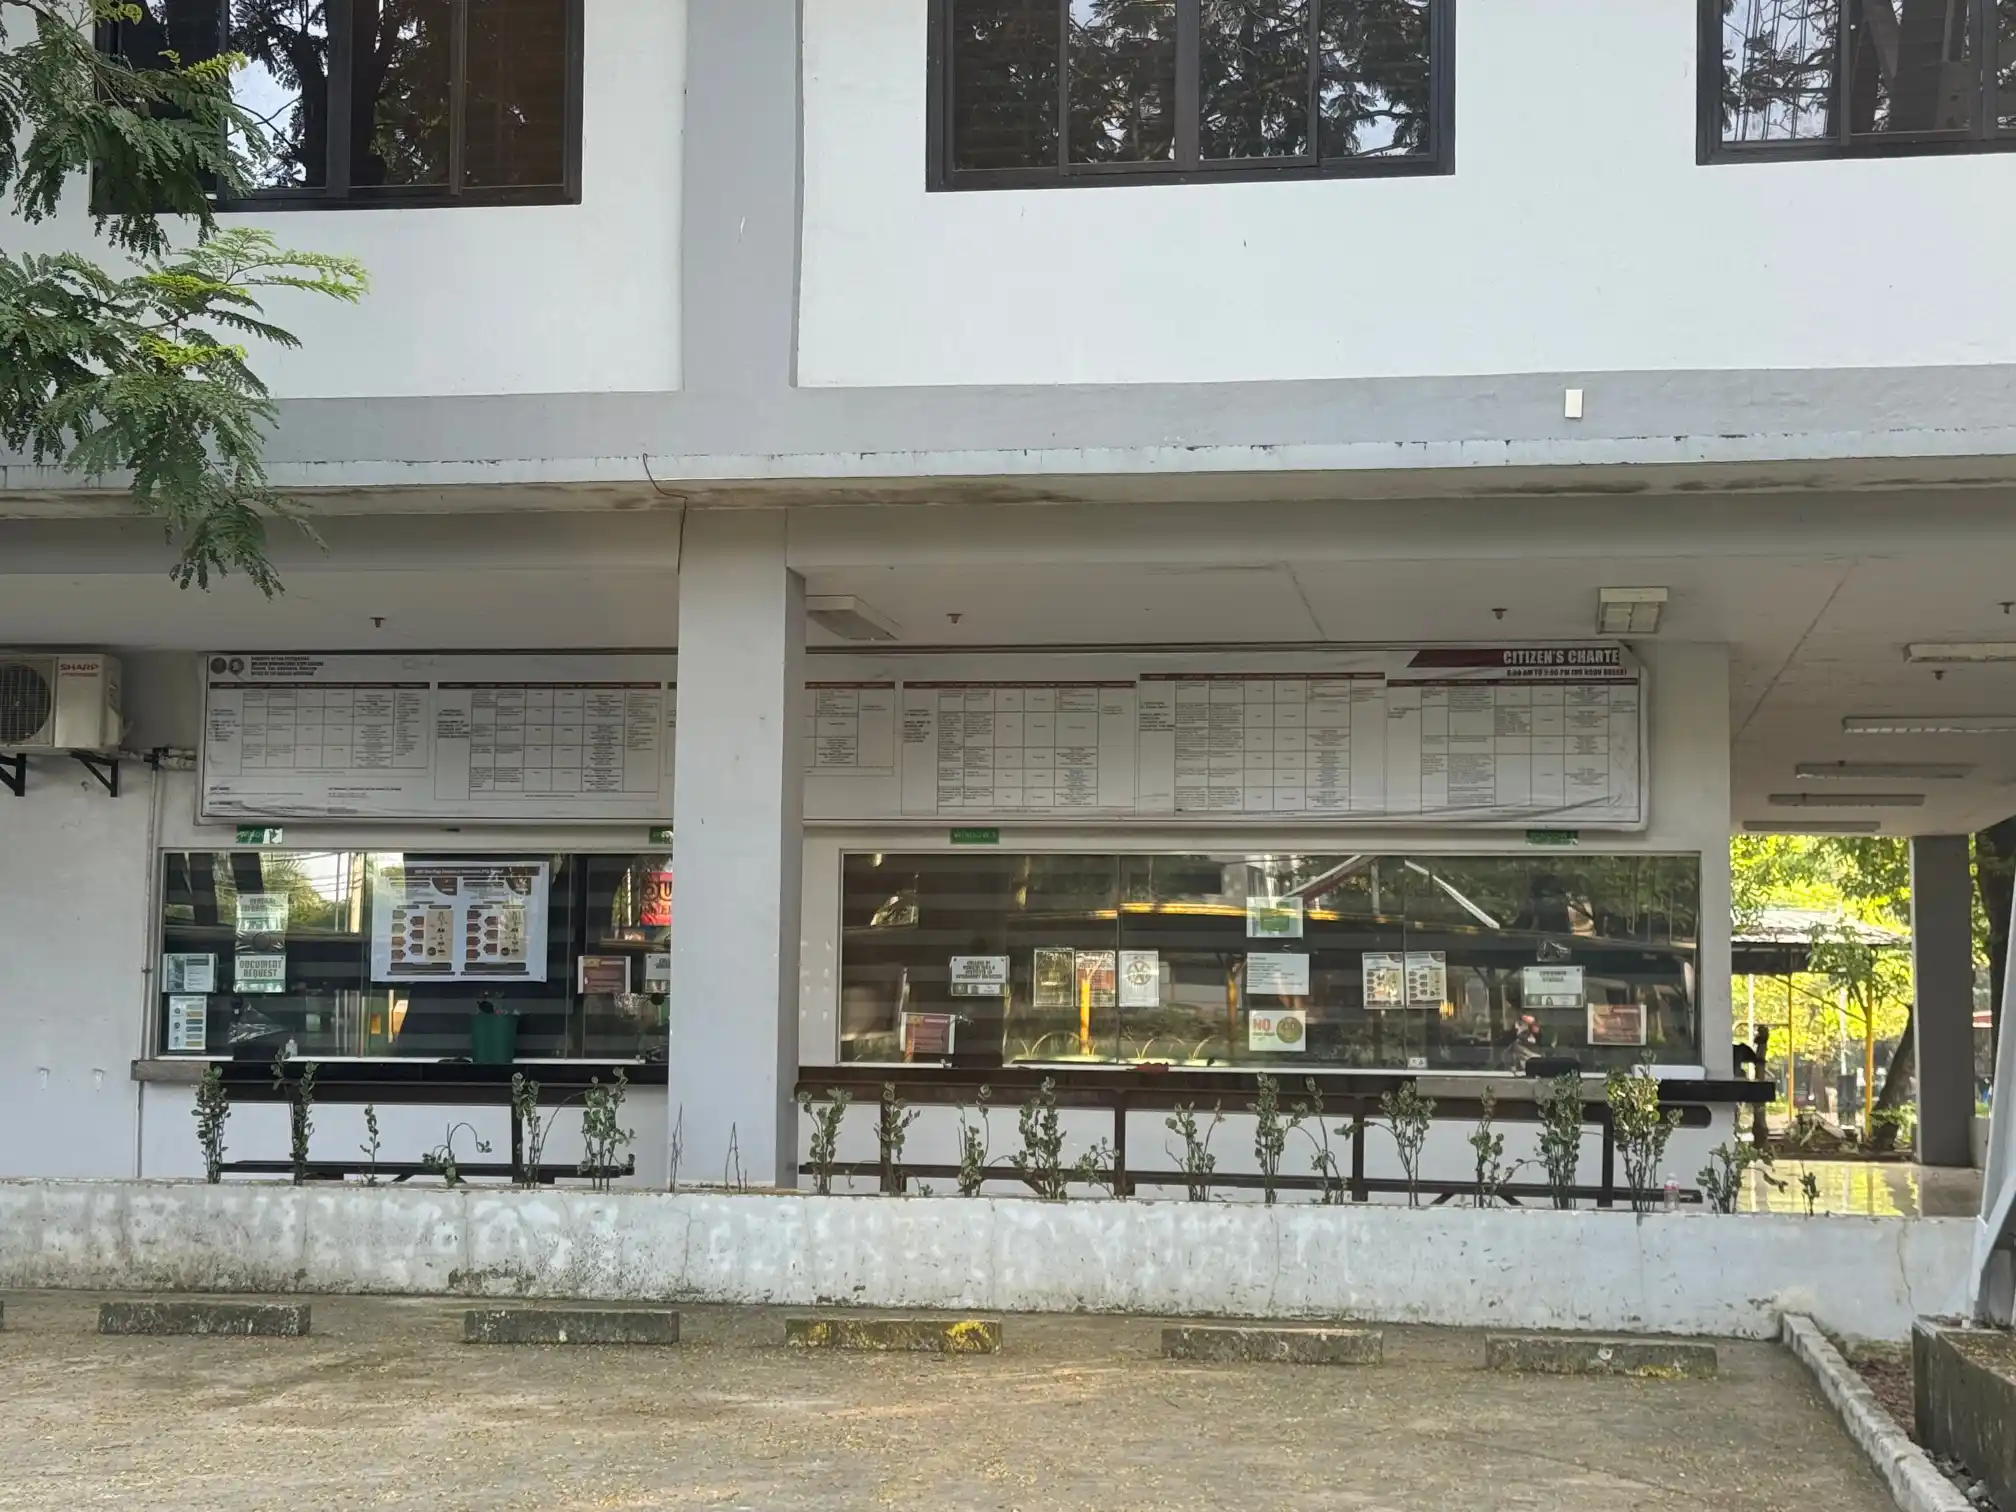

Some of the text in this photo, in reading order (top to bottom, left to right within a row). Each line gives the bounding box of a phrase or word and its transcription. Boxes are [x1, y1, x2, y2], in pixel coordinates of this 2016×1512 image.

[1503, 650, 1565, 665] CITIZEN'S
[59, 662, 100, 671] SHARP
[239, 960, 282, 969] DOCUMENT
[243, 968, 277, 978] REQUEST
